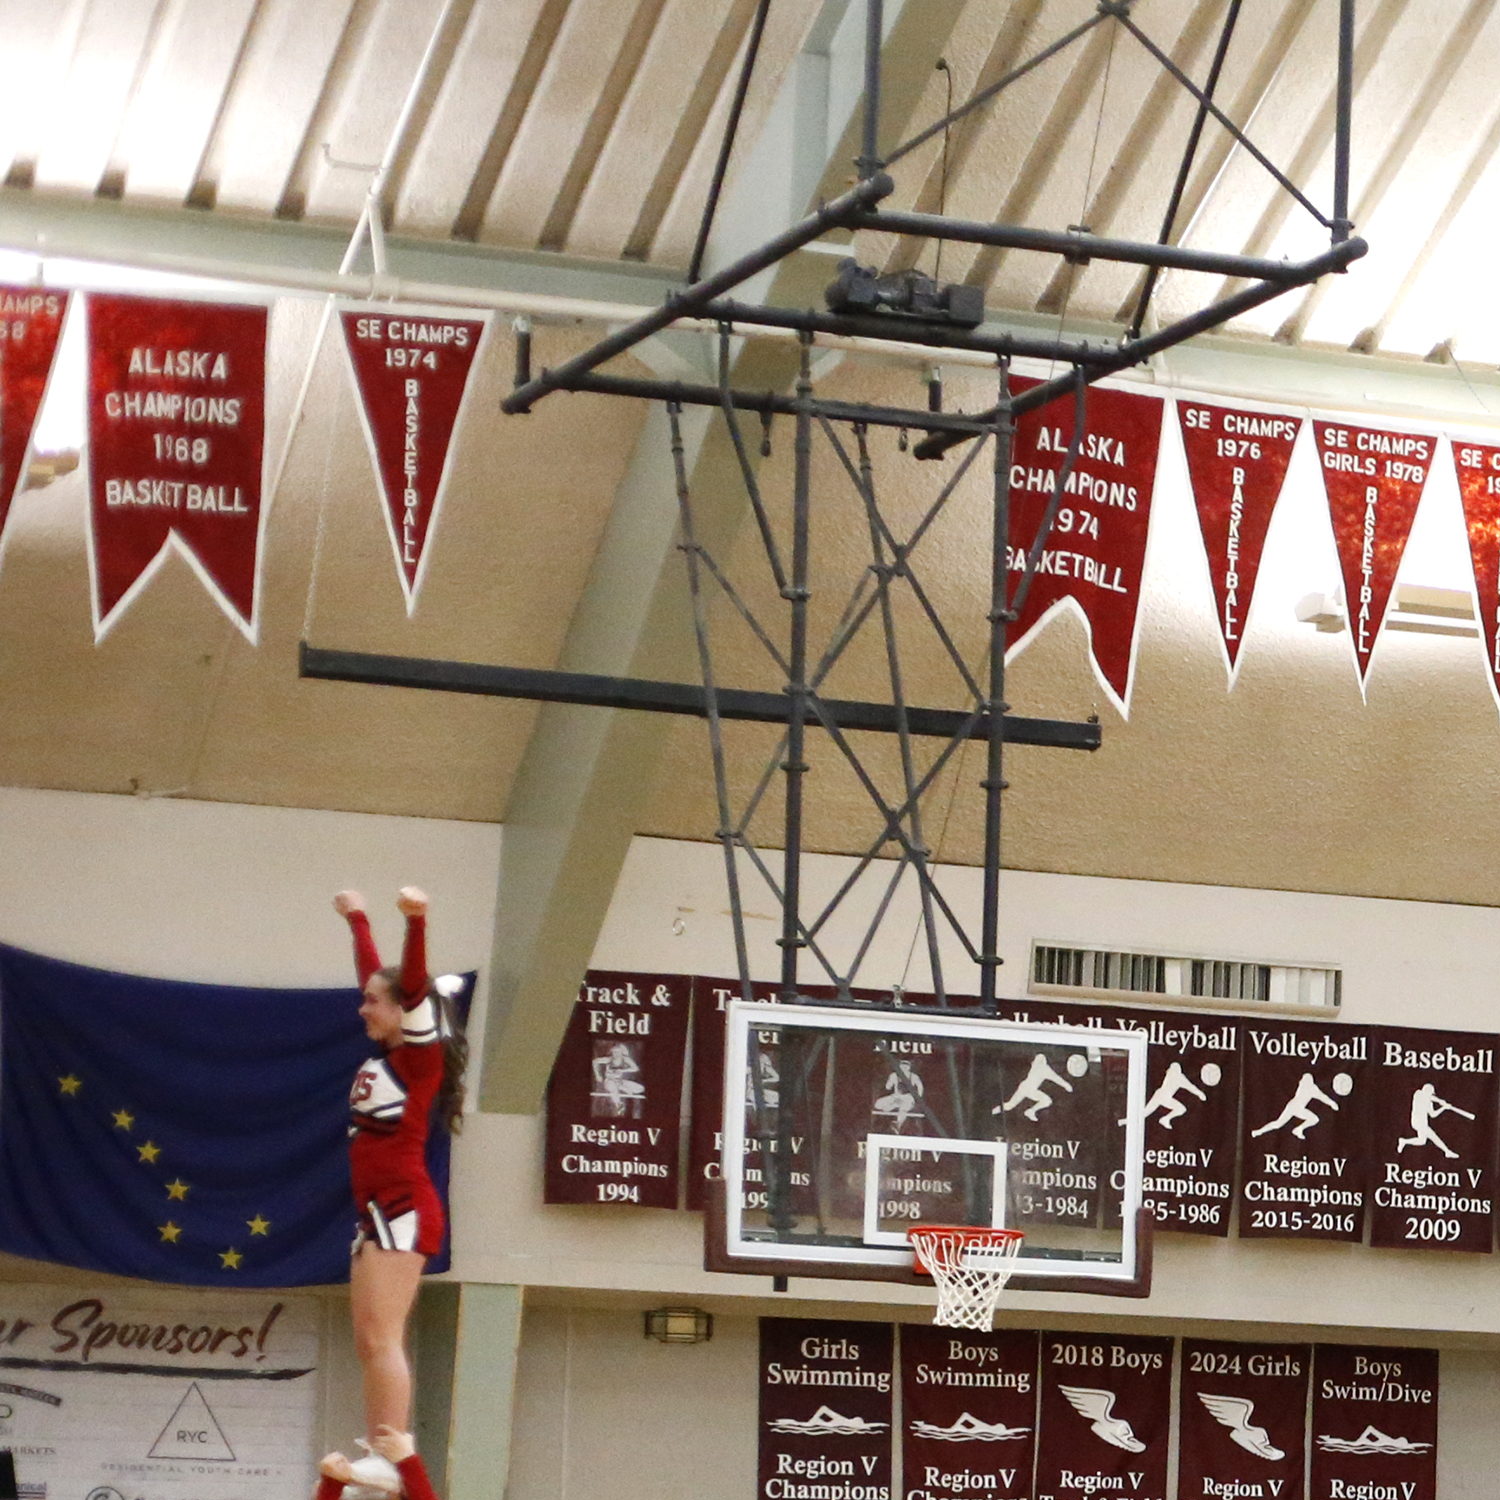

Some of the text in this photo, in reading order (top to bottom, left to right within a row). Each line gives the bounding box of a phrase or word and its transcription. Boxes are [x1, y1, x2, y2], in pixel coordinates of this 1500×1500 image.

[357, 319, 467, 346] SE CHAMPS
[129, 348, 226, 379] ALASKA
[386, 348, 435, 368] 1974
[105, 392, 240, 424] CHAMPIONS
[1186, 409, 1295, 440] SE CHAMPS
[154, 434, 208, 463] 1968
[1217, 439, 1261, 459] 1976
[1325, 429, 1429, 460] SE CHAMPS
[403, 378, 417, 563] BASKETBALL
[1324, 452, 1424, 483] GIRLS 1978
[106, 480, 247, 512] BASKETBALL
[1225, 467, 1245, 640] BASKETBALL
[1358, 486, 1378, 653] BASKETBALL
[652, 985, 670, 1006] &
[590, 1011, 649, 1034] Field
[1249, 1031, 1366, 1064] Volleyball
[1383, 1042, 1492, 1073] Baseball
[572, 1125, 660, 1146] Region V
[562, 1155, 667, 1177] Champions
[1264, 1154, 1346, 1178] Region V
[1385, 1163, 1481, 1188] Region V
[598, 1184, 638, 1202] 1994
[1245, 1181, 1362, 1207] Champions
[1375, 1187, 1490, 1214] Champions
[1252, 1211, 1354, 1232] 2015-2016
[1405, 1218, 1460, 1240] 2009
[51, 1299, 283, 1361] Sponsors!
[801, 1338, 859, 1360] Girls
[950, 1341, 998, 1367] Boys
[1053, 1344, 1162, 1375] 2018 Boys
[1191, 1352, 1300, 1376] 2024 Girls
[1355, 1357, 1401, 1381] Boys
[768, 1363, 890, 1392] Swimming
[916, 1364, 1030, 1393] Swimming
[1322, 1380, 1431, 1403] Swim/Dive
[177, 1430, 208, 1444] RYC
[777, 1454, 877, 1478] Region V
